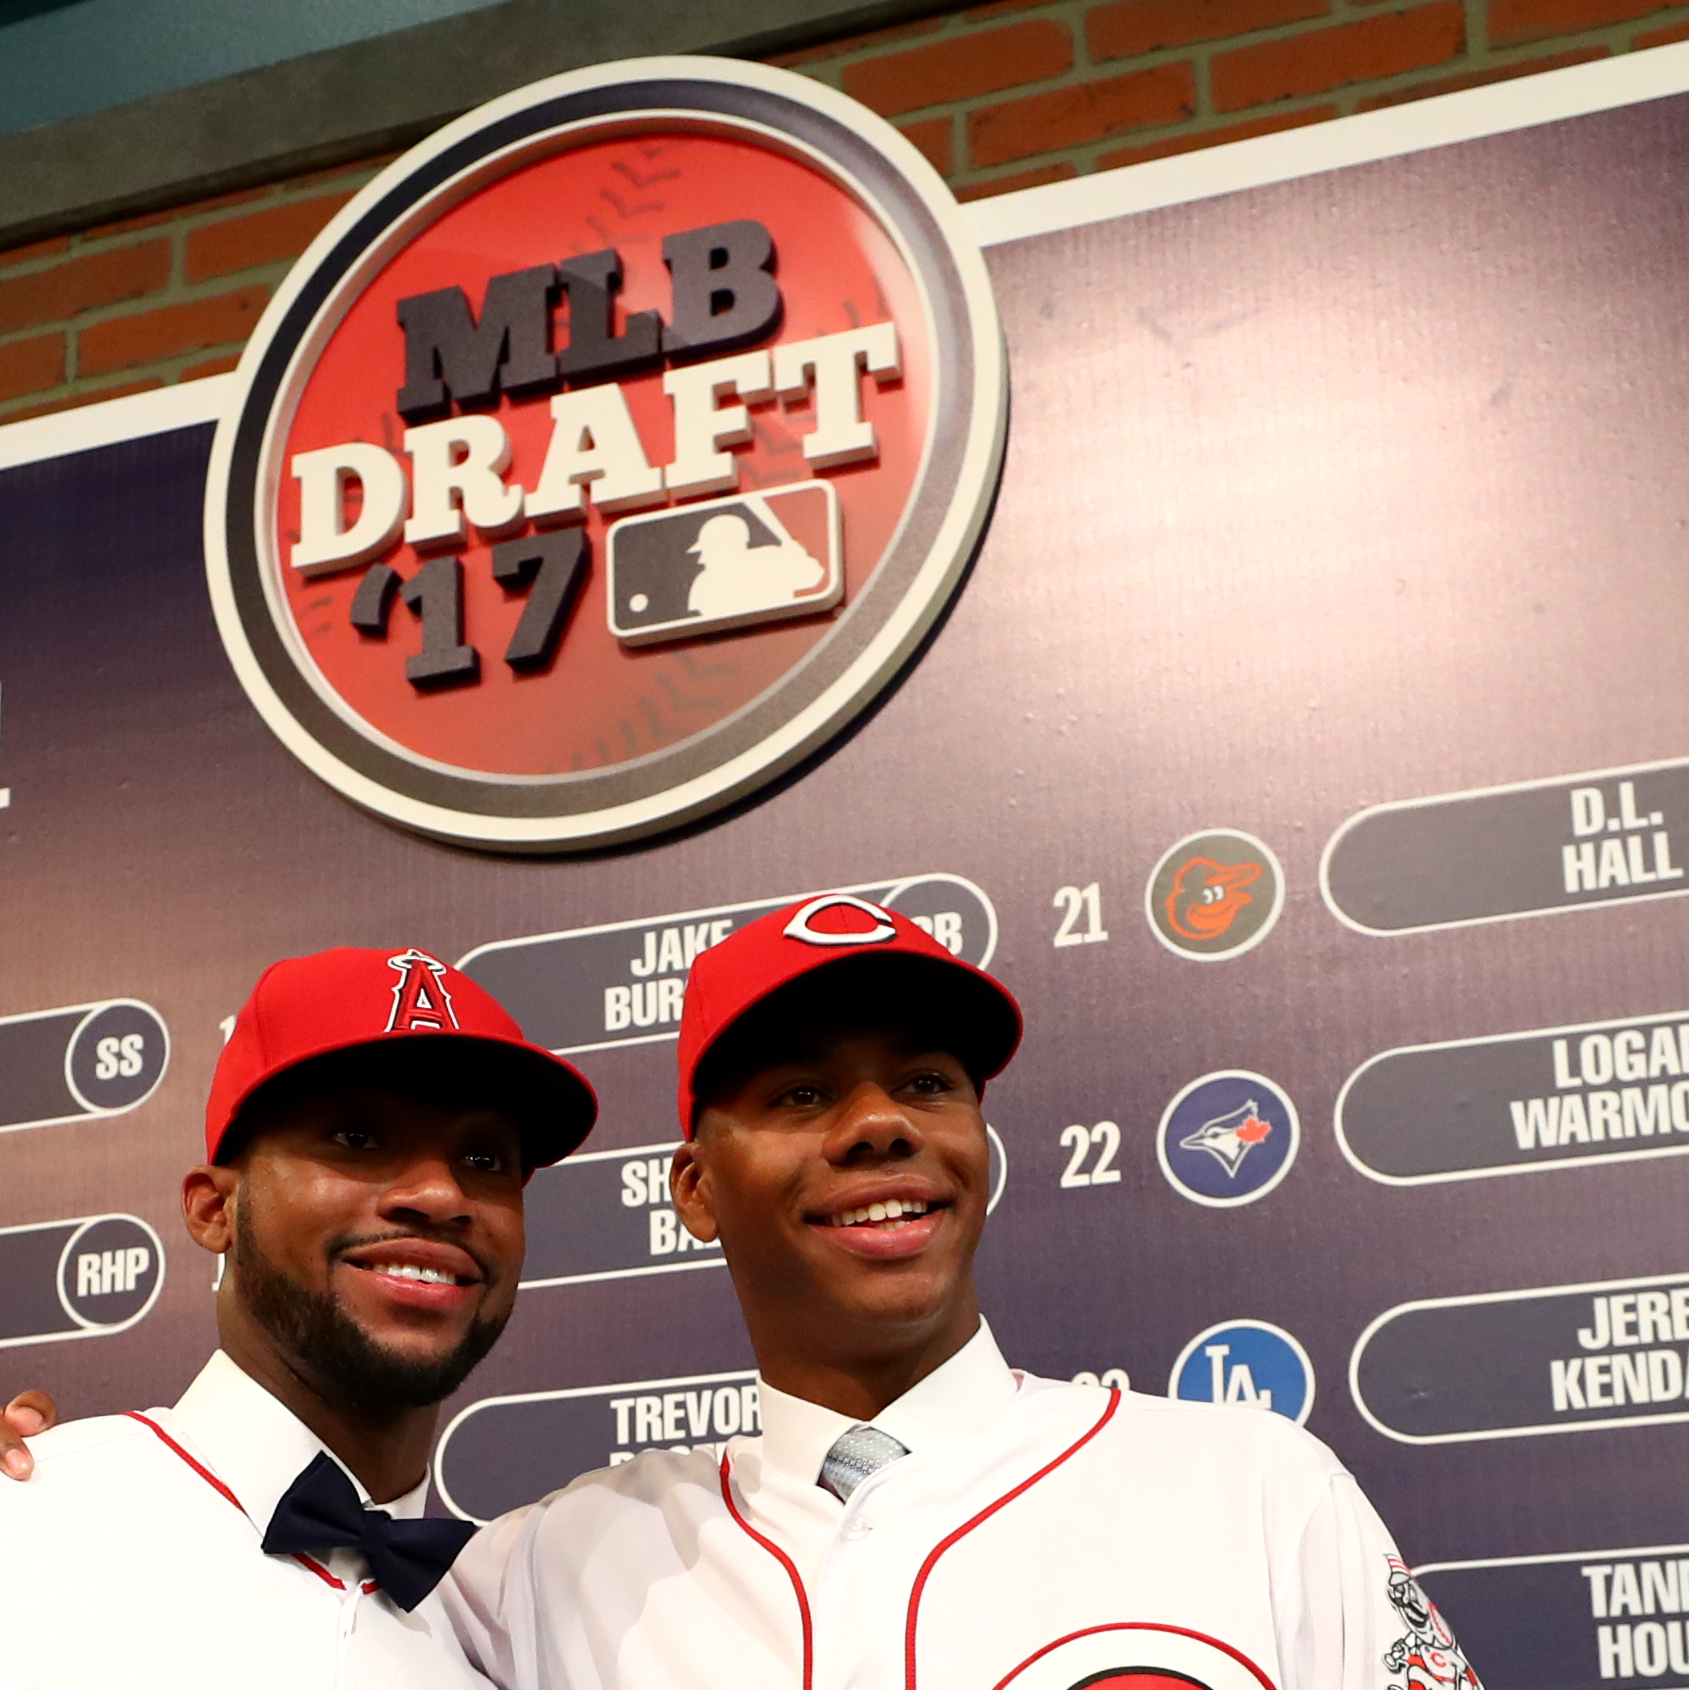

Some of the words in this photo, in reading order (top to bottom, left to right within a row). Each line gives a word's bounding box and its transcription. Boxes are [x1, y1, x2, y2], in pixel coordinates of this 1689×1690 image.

[396, 219, 785, 424] MLB
[290, 322, 904, 576] DRAFT
[1570, 781, 1663, 837] D.L.
[1562, 831, 1684, 894] HALL
[1052, 882, 1109, 948] 21
[95, 1034, 144, 1080] SS
[1059, 1121, 1121, 1189] 22
[77, 1247, 150, 1297] RHP
